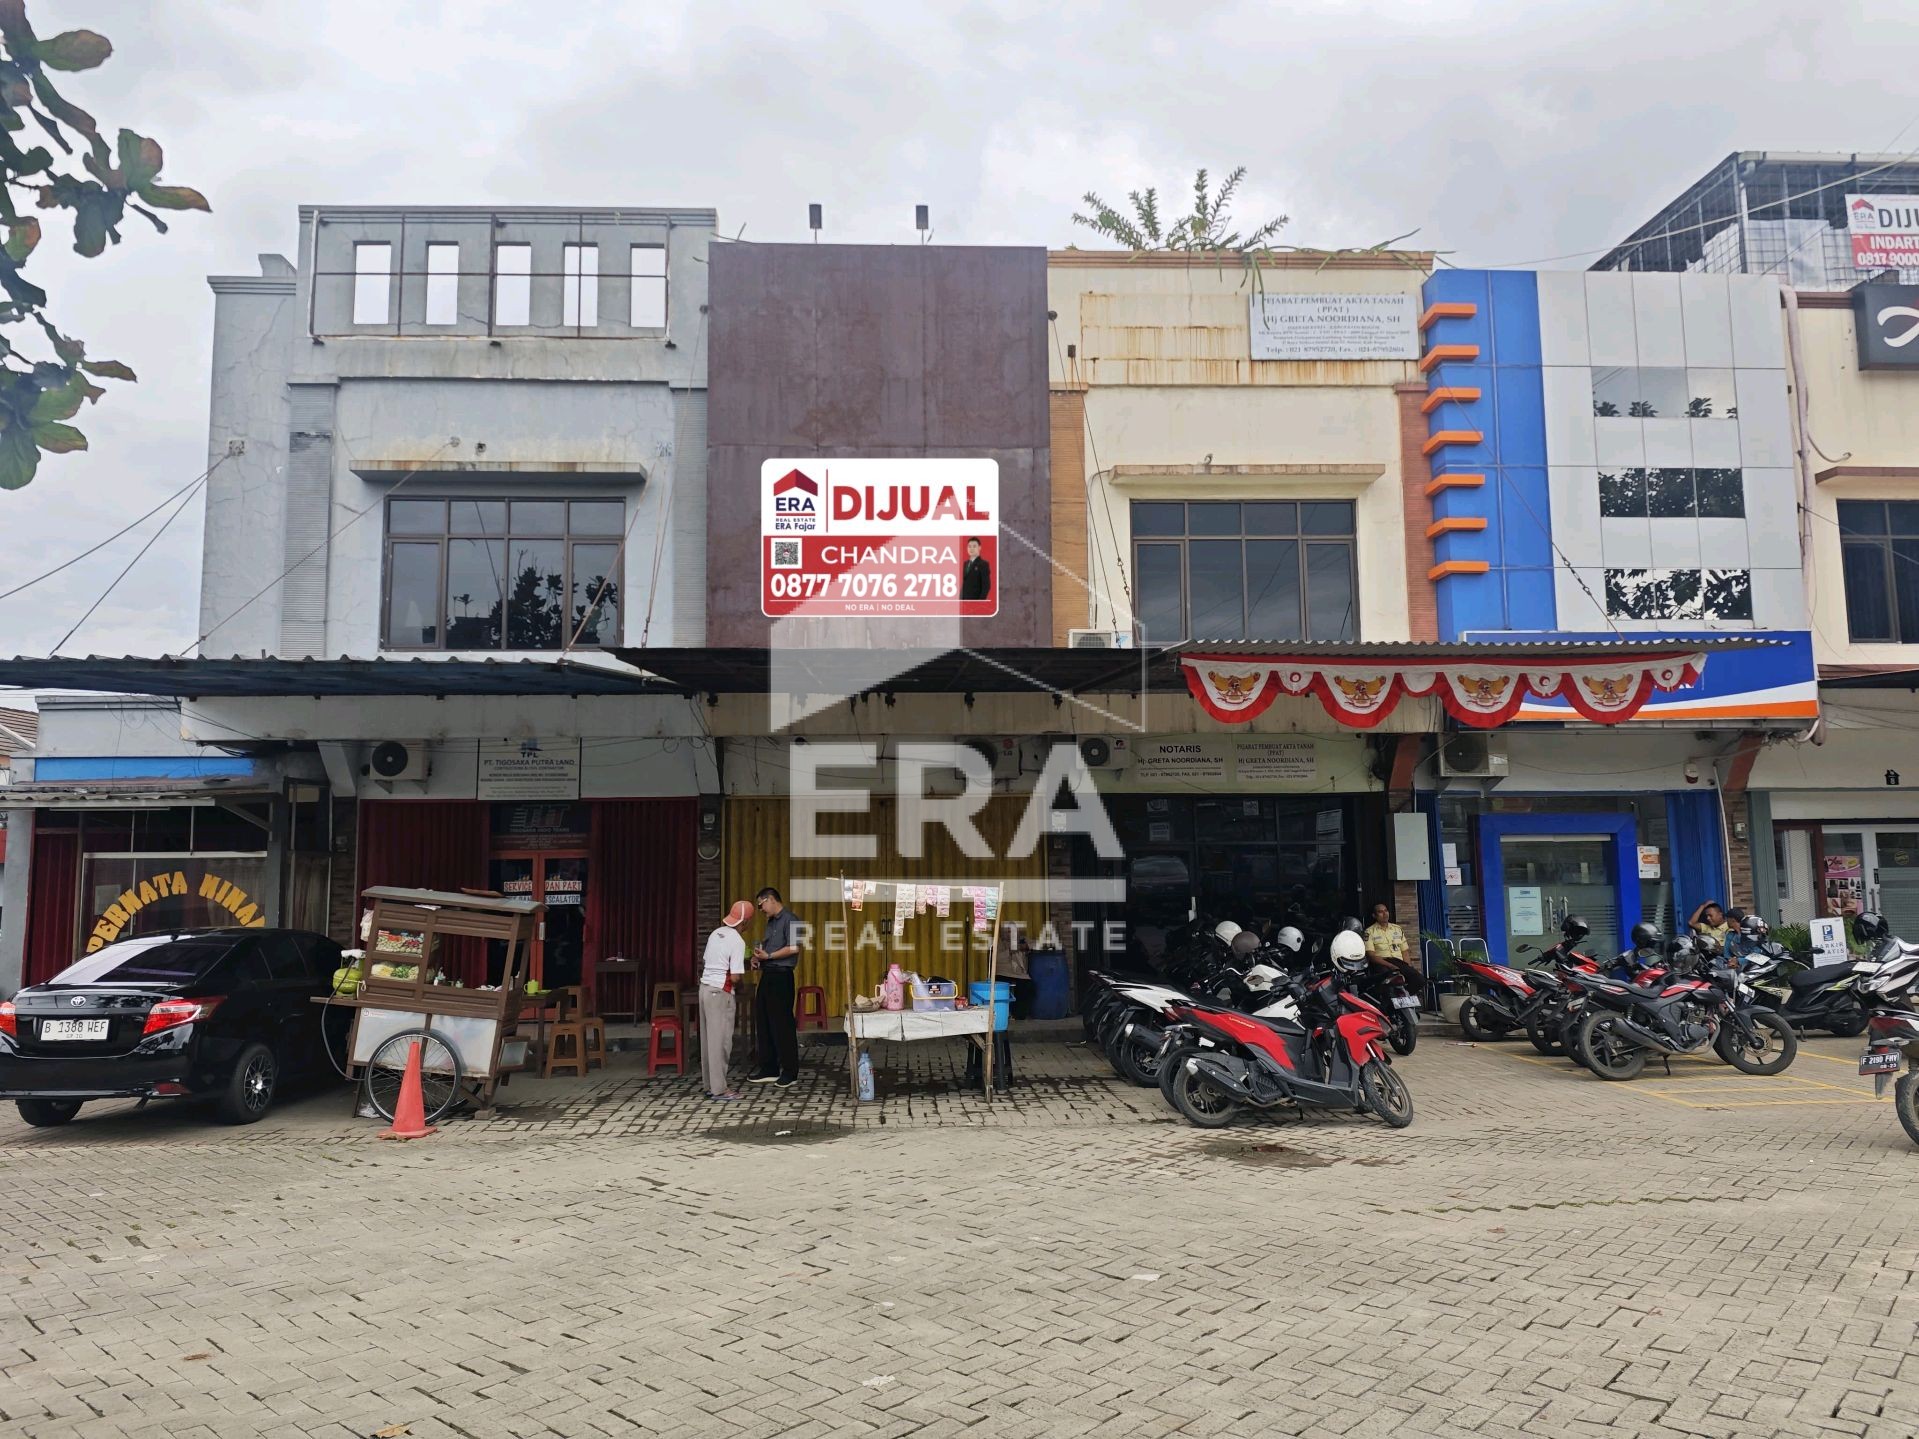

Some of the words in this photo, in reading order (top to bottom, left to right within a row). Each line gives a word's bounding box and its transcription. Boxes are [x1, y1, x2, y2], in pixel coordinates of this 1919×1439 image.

[1853, 212, 1875, 221] ERA
[1280, 315, 1314, 323] GRETA
[1317, 315, 1385, 324] NOORDIANA,
[1386, 315, 1401, 323] SH
[775, 497, 816, 512] ERA
[833, 485, 990, 521] DIJUAL
[775, 522, 792, 530] ERA
[794, 522, 816, 532] Fajar
[821, 545, 957, 565] CHANDRA
[770, 573, 831, 598] 0877
[838, 573, 898, 598] 7076
[904, 573, 958, 598] 2718
[845, 603, 857, 612] NO
[858, 603, 875, 612] ERA
[881, 603, 893, 612] NO
[894, 603, 916, 612] DEAL
[1159, 745, 1202, 754] NOTARIS
[504, 881, 533, 891] SERVICE
[44, 1022, 52, 1033] B
[58, 1021, 84, 1033] 1388
[87, 1021, 107, 1033] WEF
[1862, 1057, 1867, 1065] F
